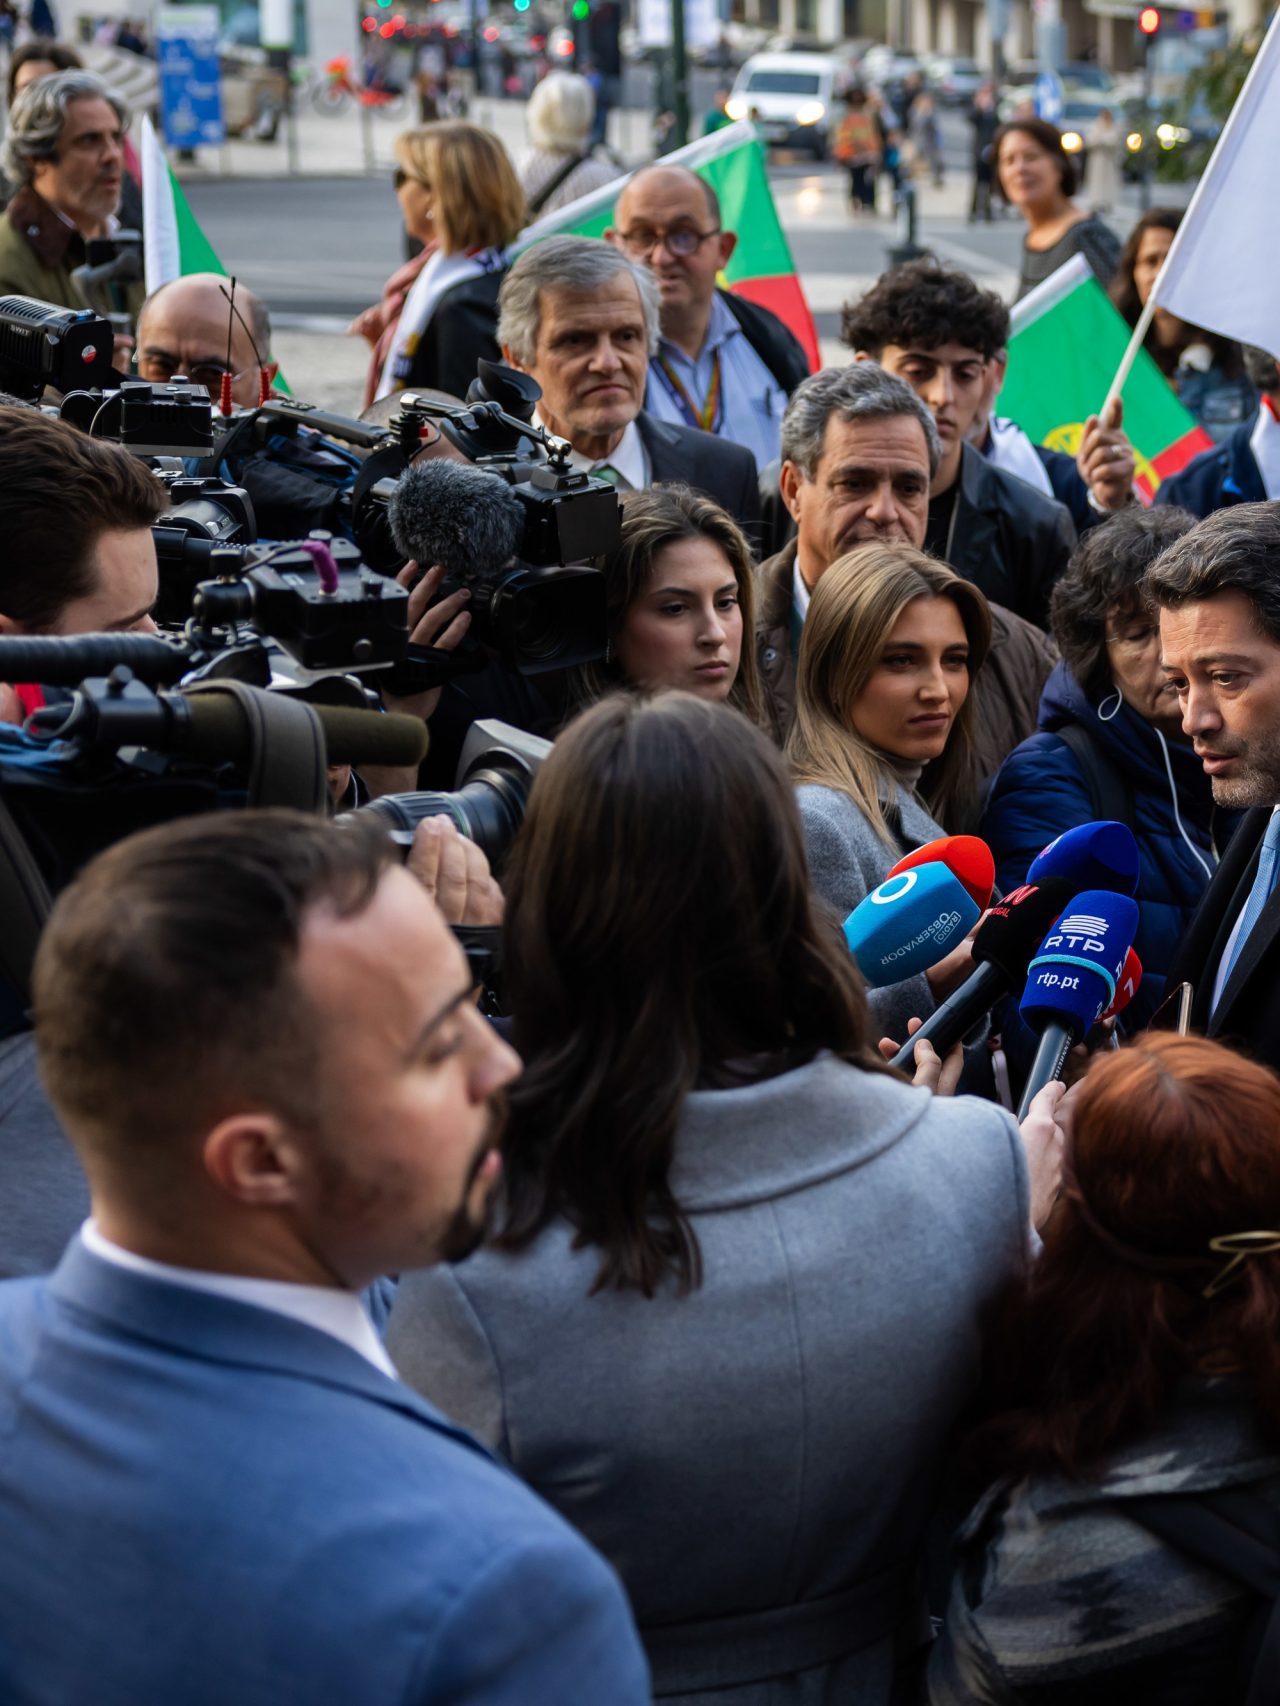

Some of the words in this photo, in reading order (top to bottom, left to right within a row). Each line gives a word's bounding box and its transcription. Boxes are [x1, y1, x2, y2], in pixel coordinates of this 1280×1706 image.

[880, 912, 950, 965] OBSERVADOR
[1044, 935, 1105, 953] RTP
[1036, 972, 1080, 990] rtp.pt
[1053, 1034, 1072, 1081] SENNHEISE
